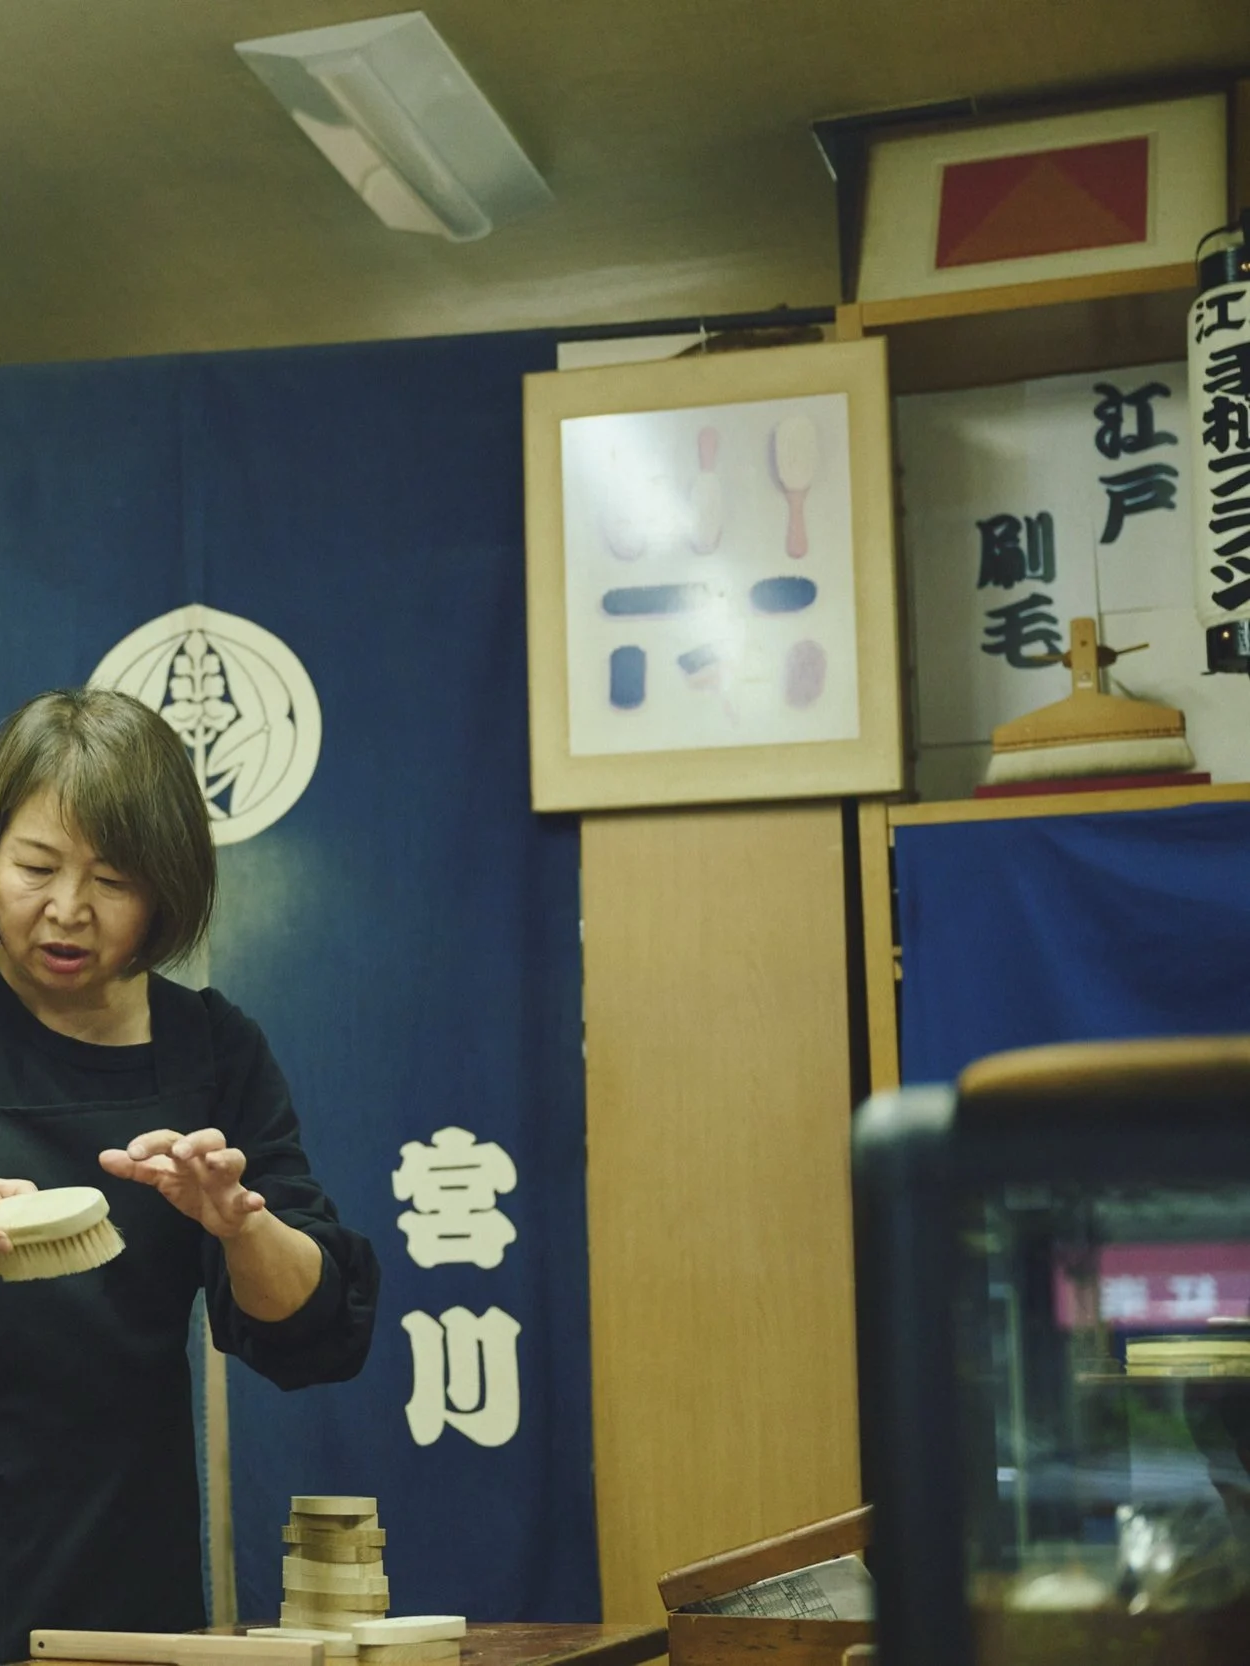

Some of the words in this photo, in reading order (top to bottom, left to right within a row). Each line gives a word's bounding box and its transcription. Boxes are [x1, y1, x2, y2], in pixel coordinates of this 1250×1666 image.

[1196, 290, 1250, 343] 江
[1093, 381, 1179, 544] 江戸
[975, 510, 1063, 669] 刷毛
[392, 1126, 522, 1447] 宮川
